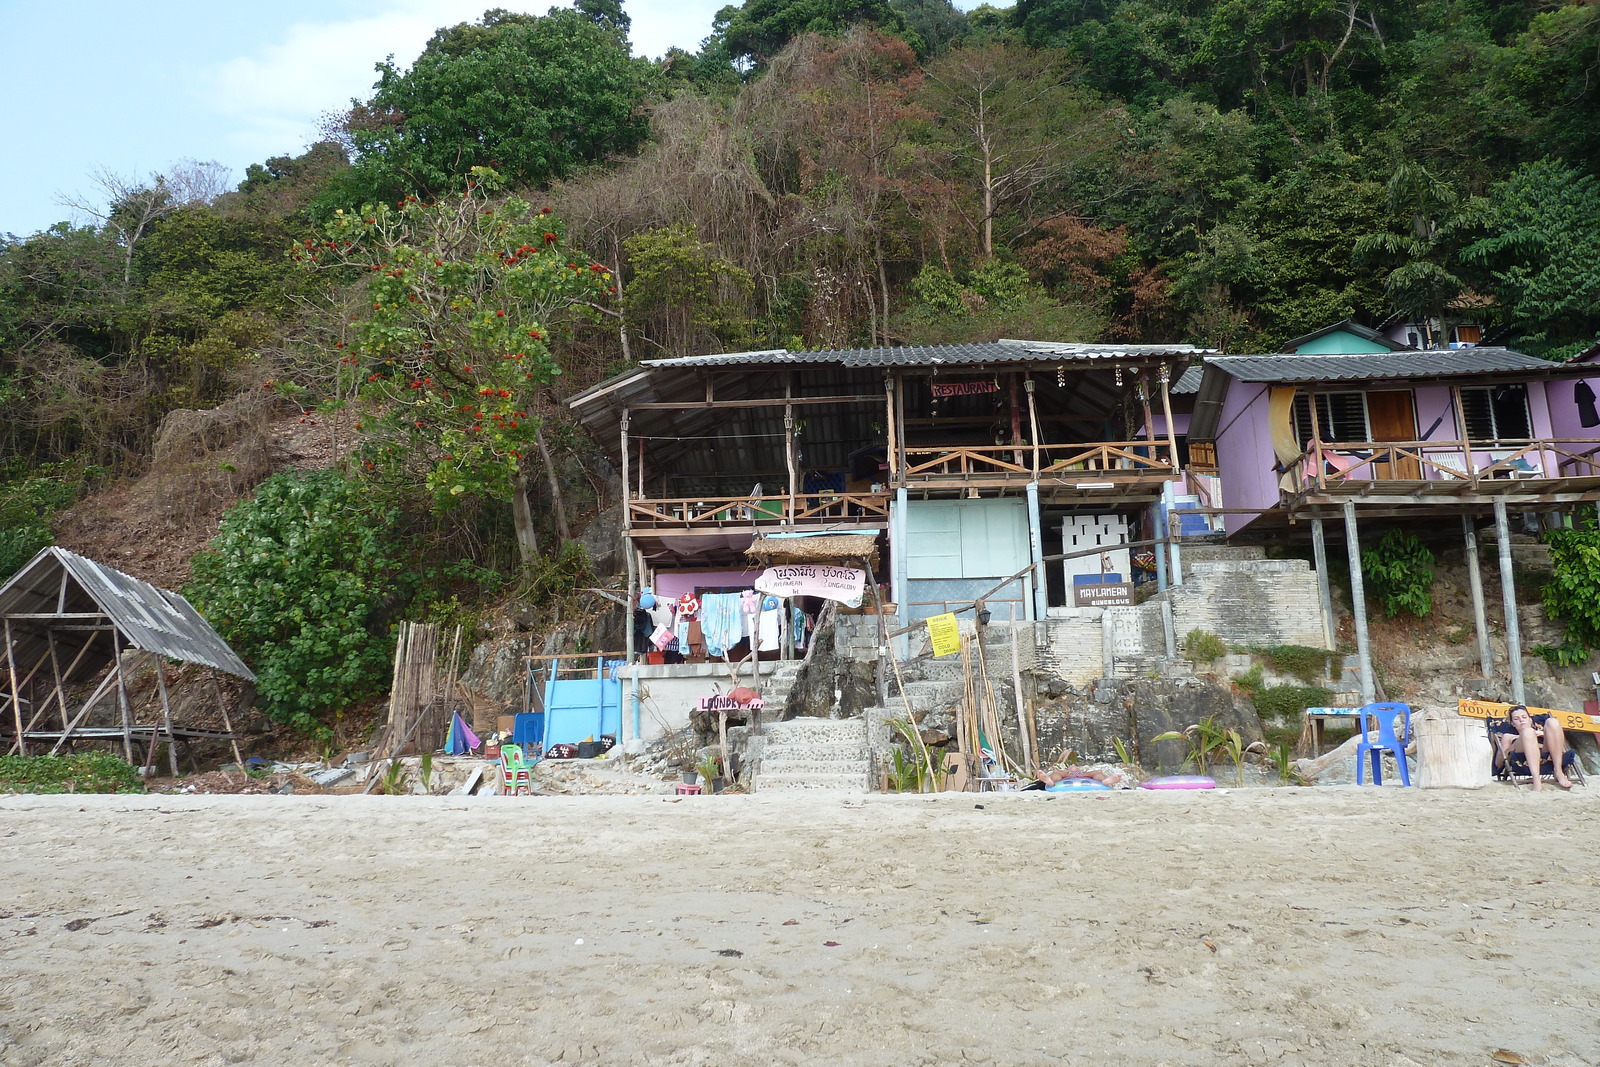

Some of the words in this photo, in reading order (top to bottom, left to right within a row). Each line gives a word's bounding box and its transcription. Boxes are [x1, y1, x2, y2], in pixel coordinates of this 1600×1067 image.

[933, 382, 995, 396] RESTAURANT
[1080, 587, 1128, 599] MAYLAMEAN
[1462, 705, 1499, 717] TODAY
